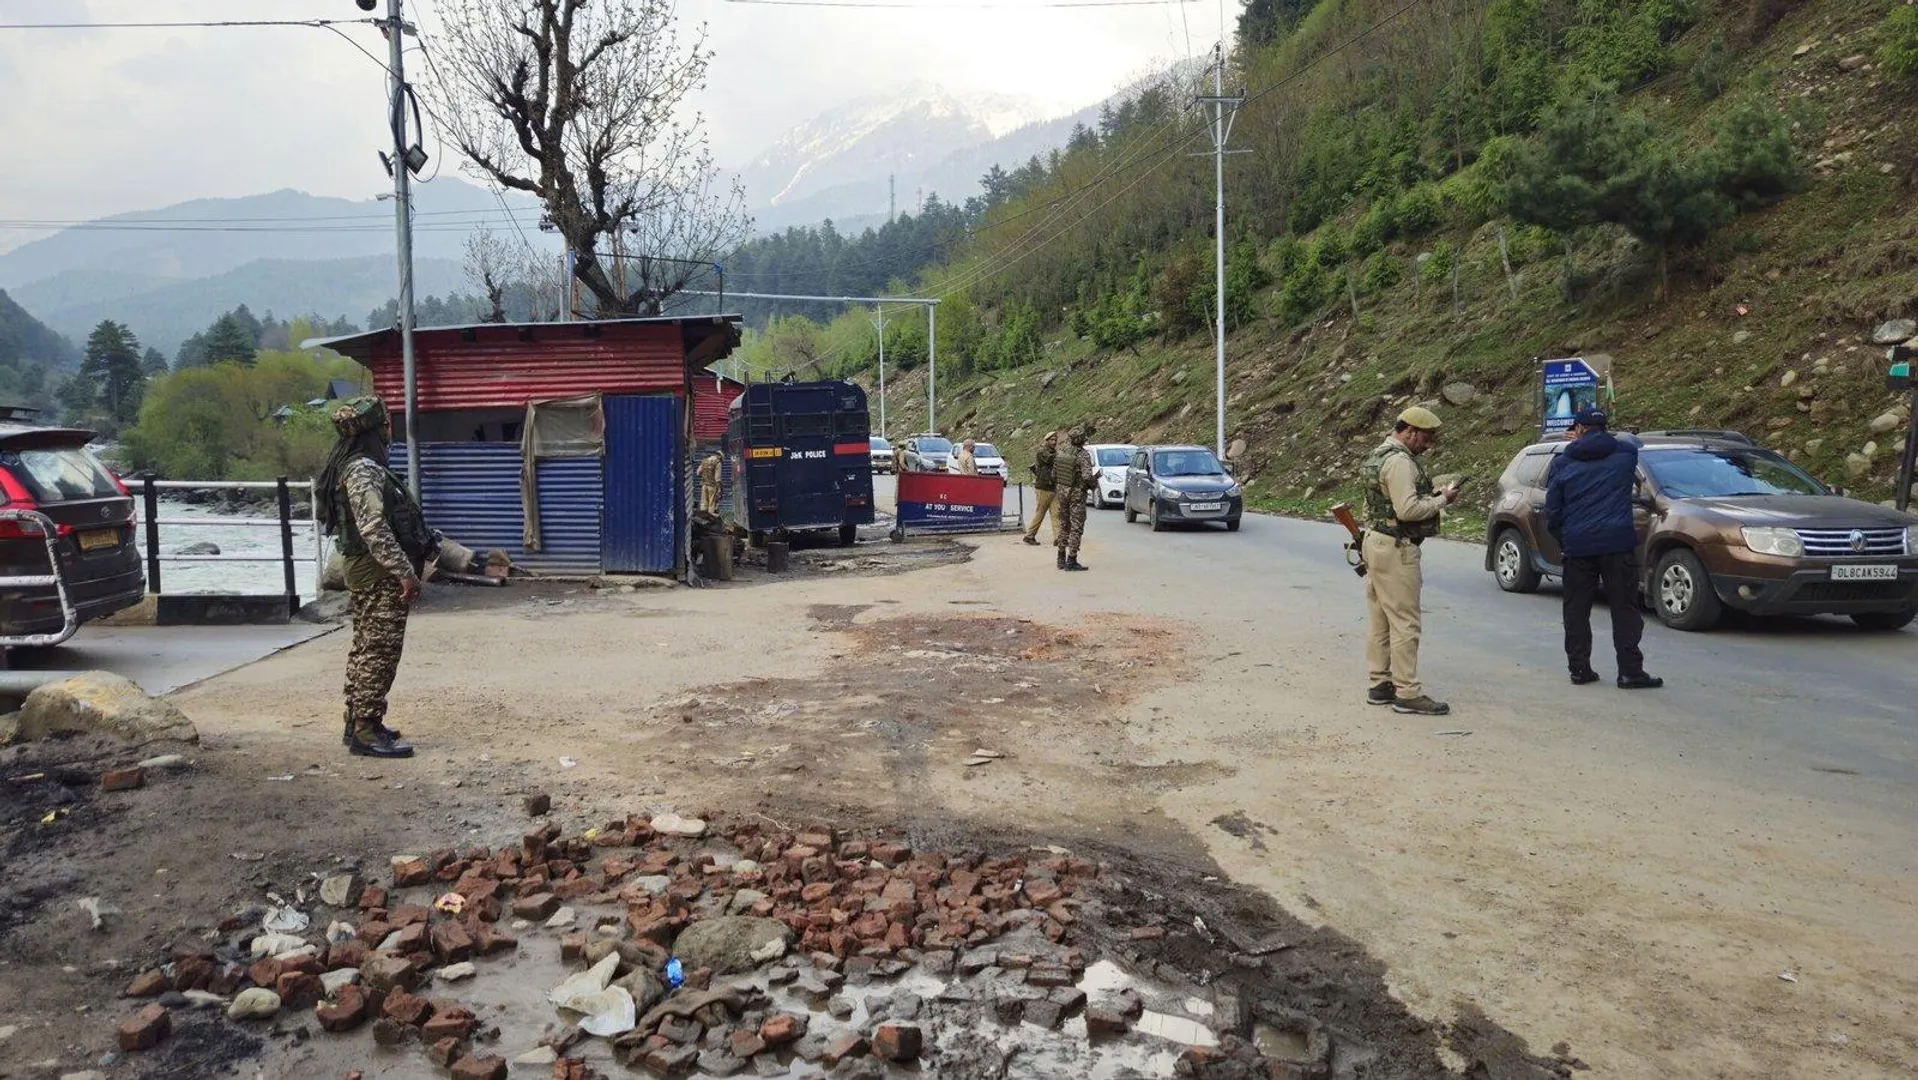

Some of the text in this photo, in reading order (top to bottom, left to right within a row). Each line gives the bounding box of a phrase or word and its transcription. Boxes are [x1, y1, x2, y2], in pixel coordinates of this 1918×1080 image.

[790, 451, 803, 460] J&K
[805, 450, 826, 458] POLICE
[934, 503, 946, 511] YOU
[950, 504, 974, 513] SERVICE
[1837, 568, 1896, 578] DL8CAK5944
